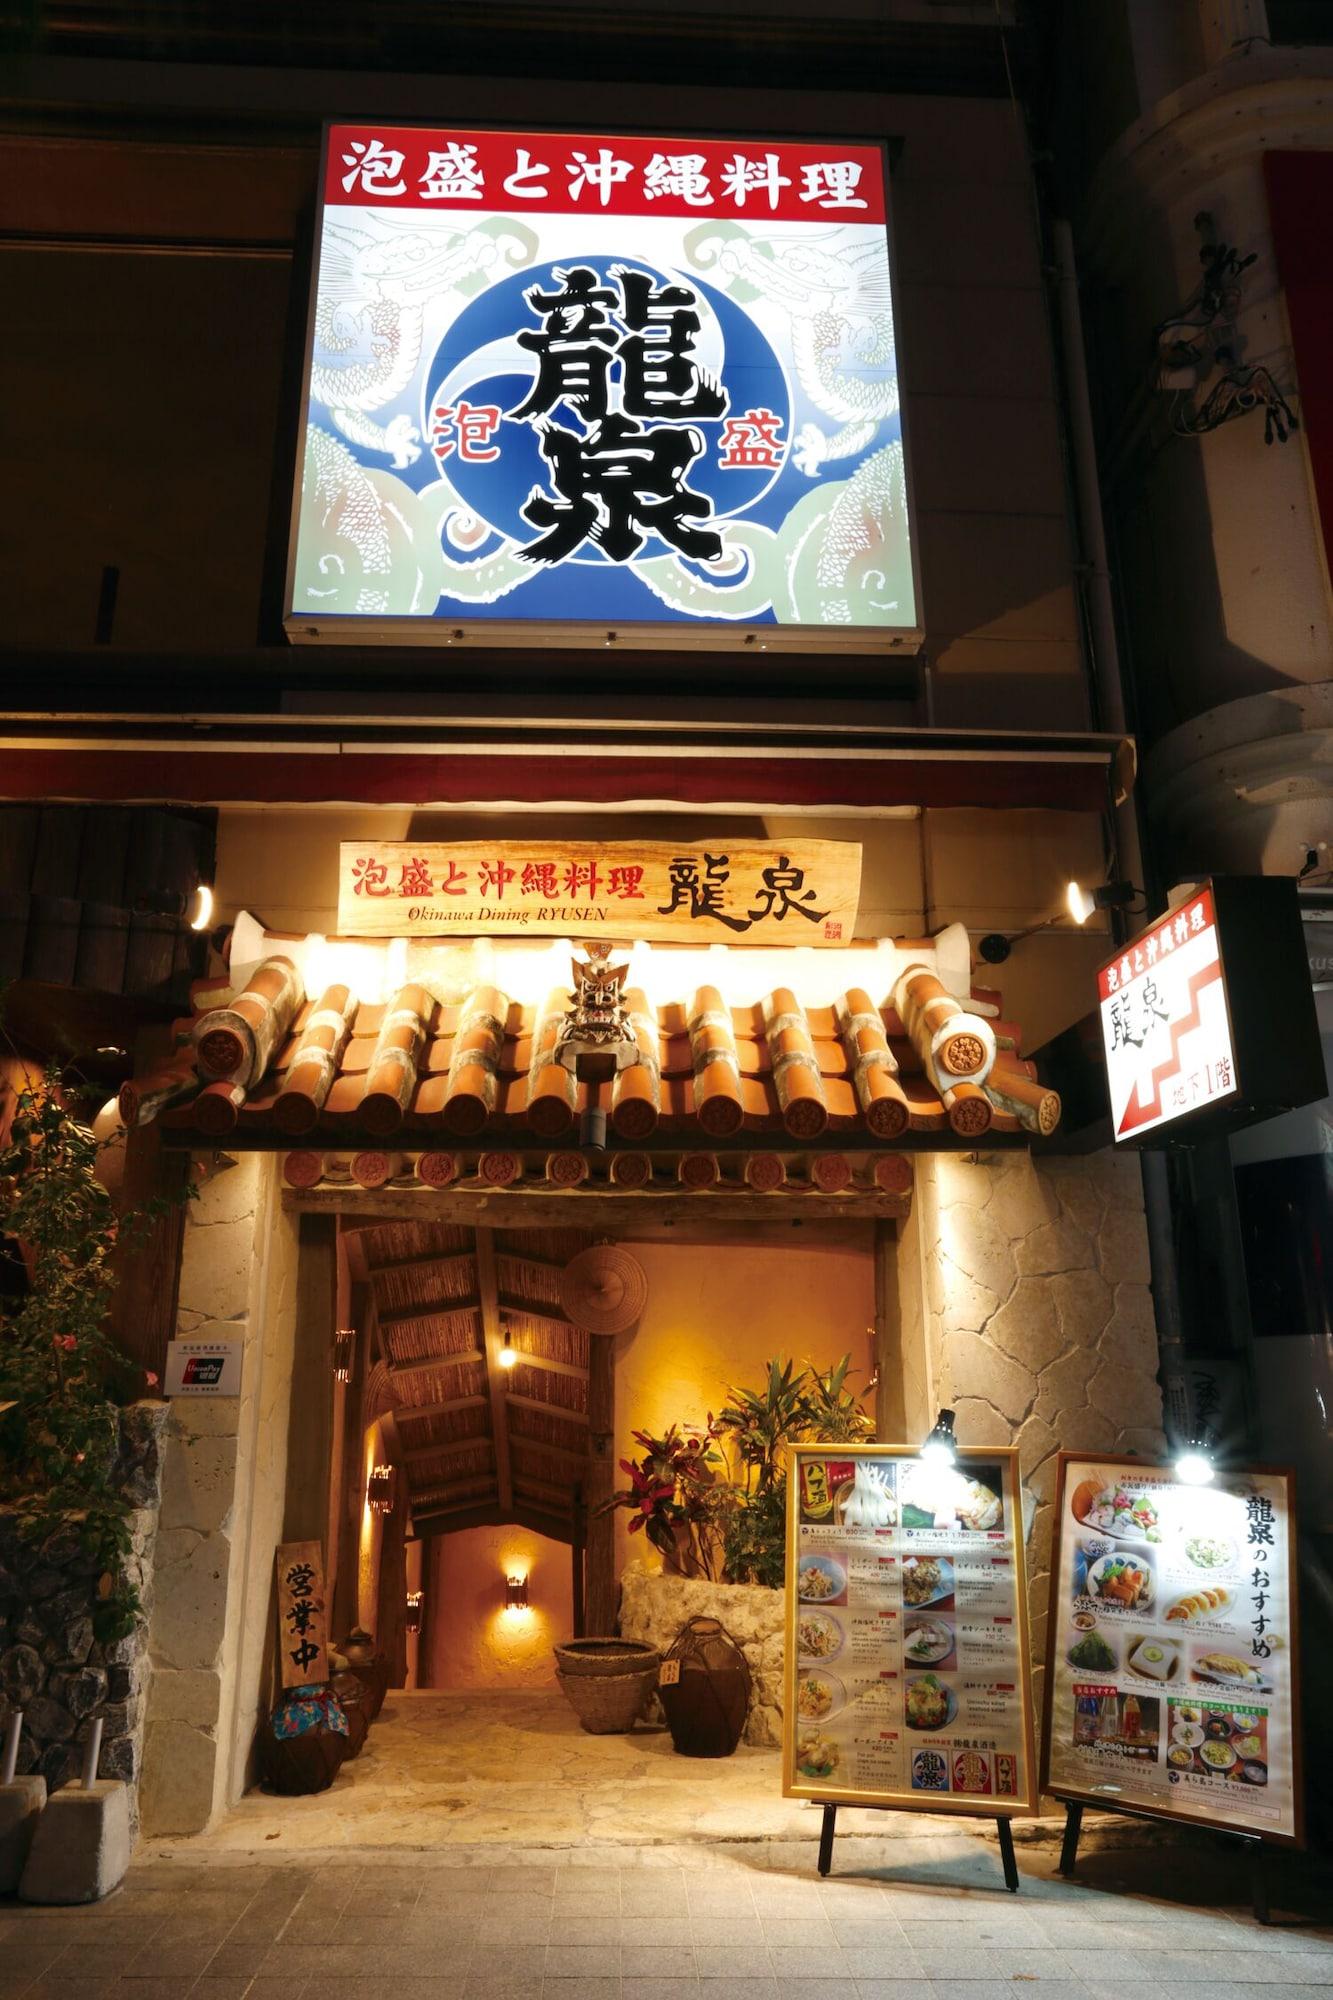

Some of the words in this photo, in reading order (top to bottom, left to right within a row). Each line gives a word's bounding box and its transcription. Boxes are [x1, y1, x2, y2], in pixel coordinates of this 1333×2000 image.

[340, 141, 869, 211] 泡盛と沖縄料理
[432, 403, 501, 463] 泡
[719, 410, 784, 471] 盛
[501, 264, 731, 567] 龍泉
[352, 857, 645, 901] 泡盛と沖縄料理
[408, 906, 473, 921] Okinawa
[478, 907, 529, 925] Dining
[537, 907, 609, 921] RYUSEN
[657, 853, 832, 933] 龍泉
[1111, 976, 1170, 1052] 龍泉
[1246, 1497, 1275, 1659] 龍泉のおすすめ
[285, 1564, 320, 1675] 営業中
